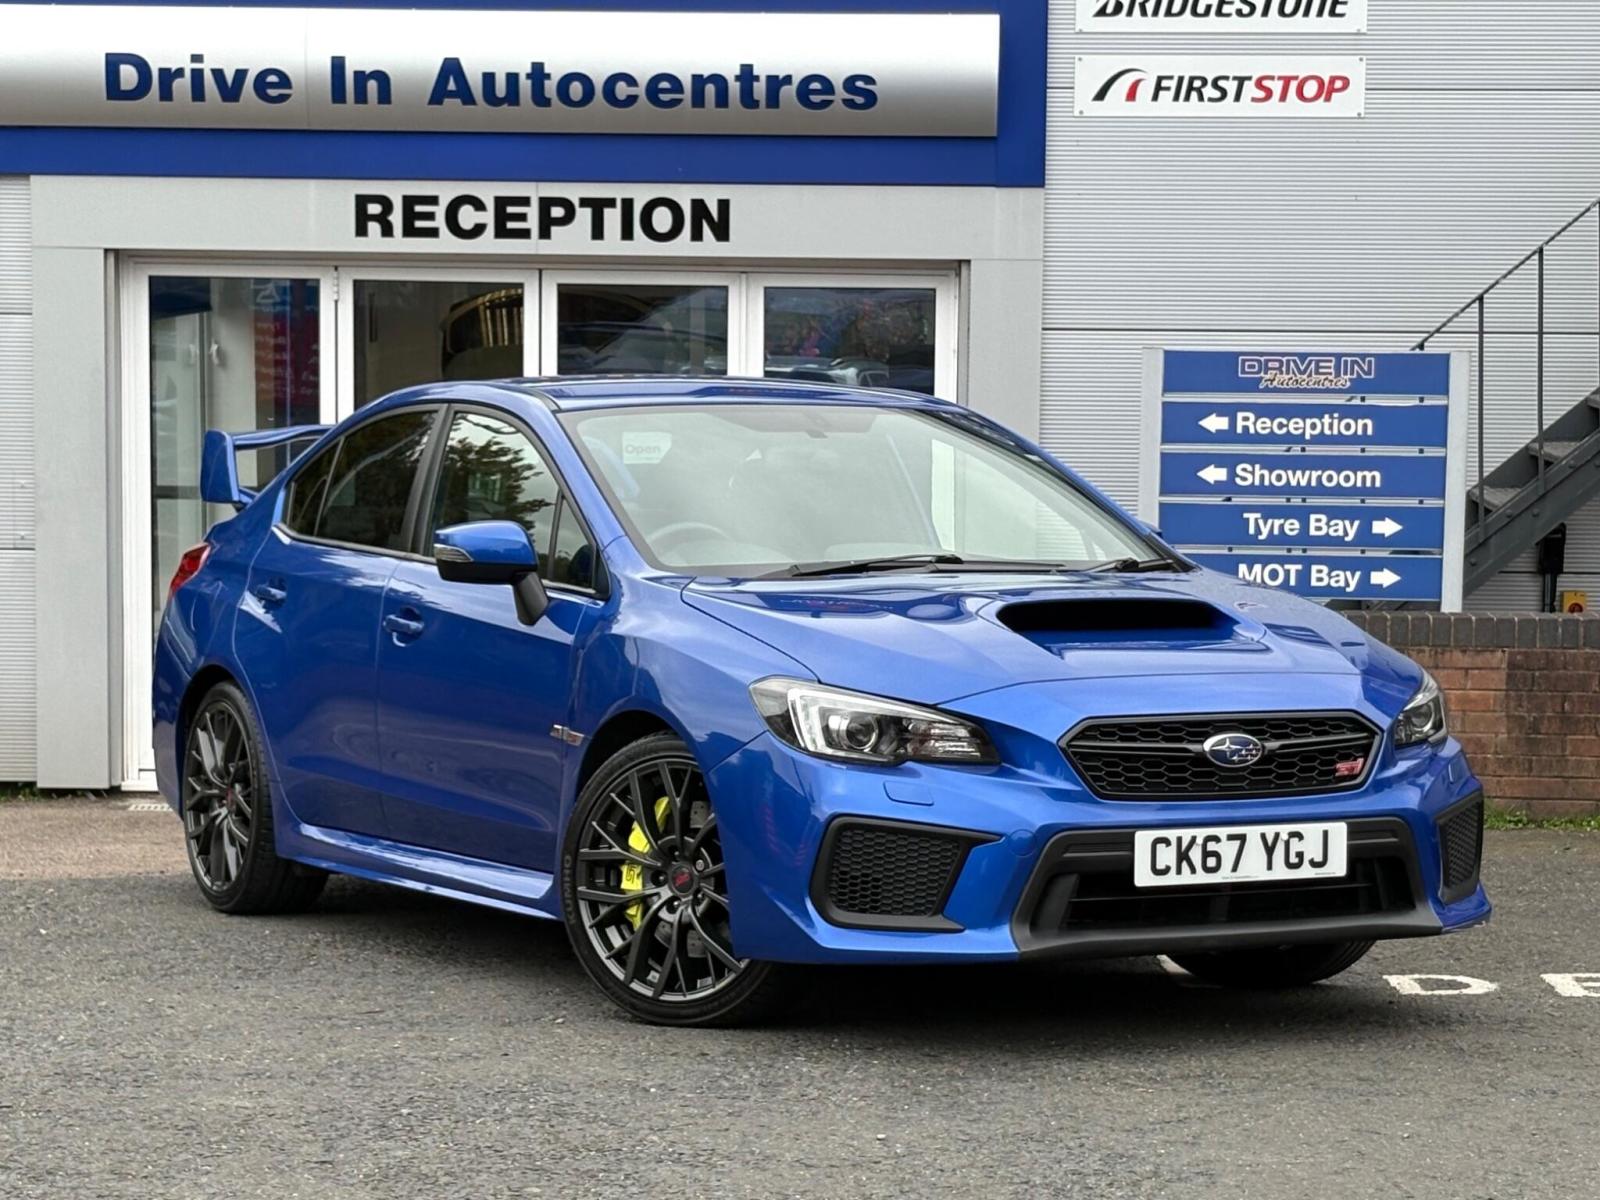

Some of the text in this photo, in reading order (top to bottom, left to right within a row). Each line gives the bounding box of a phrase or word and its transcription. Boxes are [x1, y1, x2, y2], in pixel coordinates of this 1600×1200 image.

[104, 52, 879, 111] Drive In Autocentres
[354, 193, 732, 243] RECEPTION
[1238, 356, 1375, 378] DRIVE IN
[1259, 372, 1351, 389] Autocentres
[1235, 411, 1373, 439] Reception
[625, 445, 661, 456] Open
[1234, 463, 1382, 488] Showroom
[1243, 512, 1360, 541] Tyre Bay
[1237, 563, 1361, 592] MOT Bay
[1149, 829, 1330, 877] CK67 YGJ
